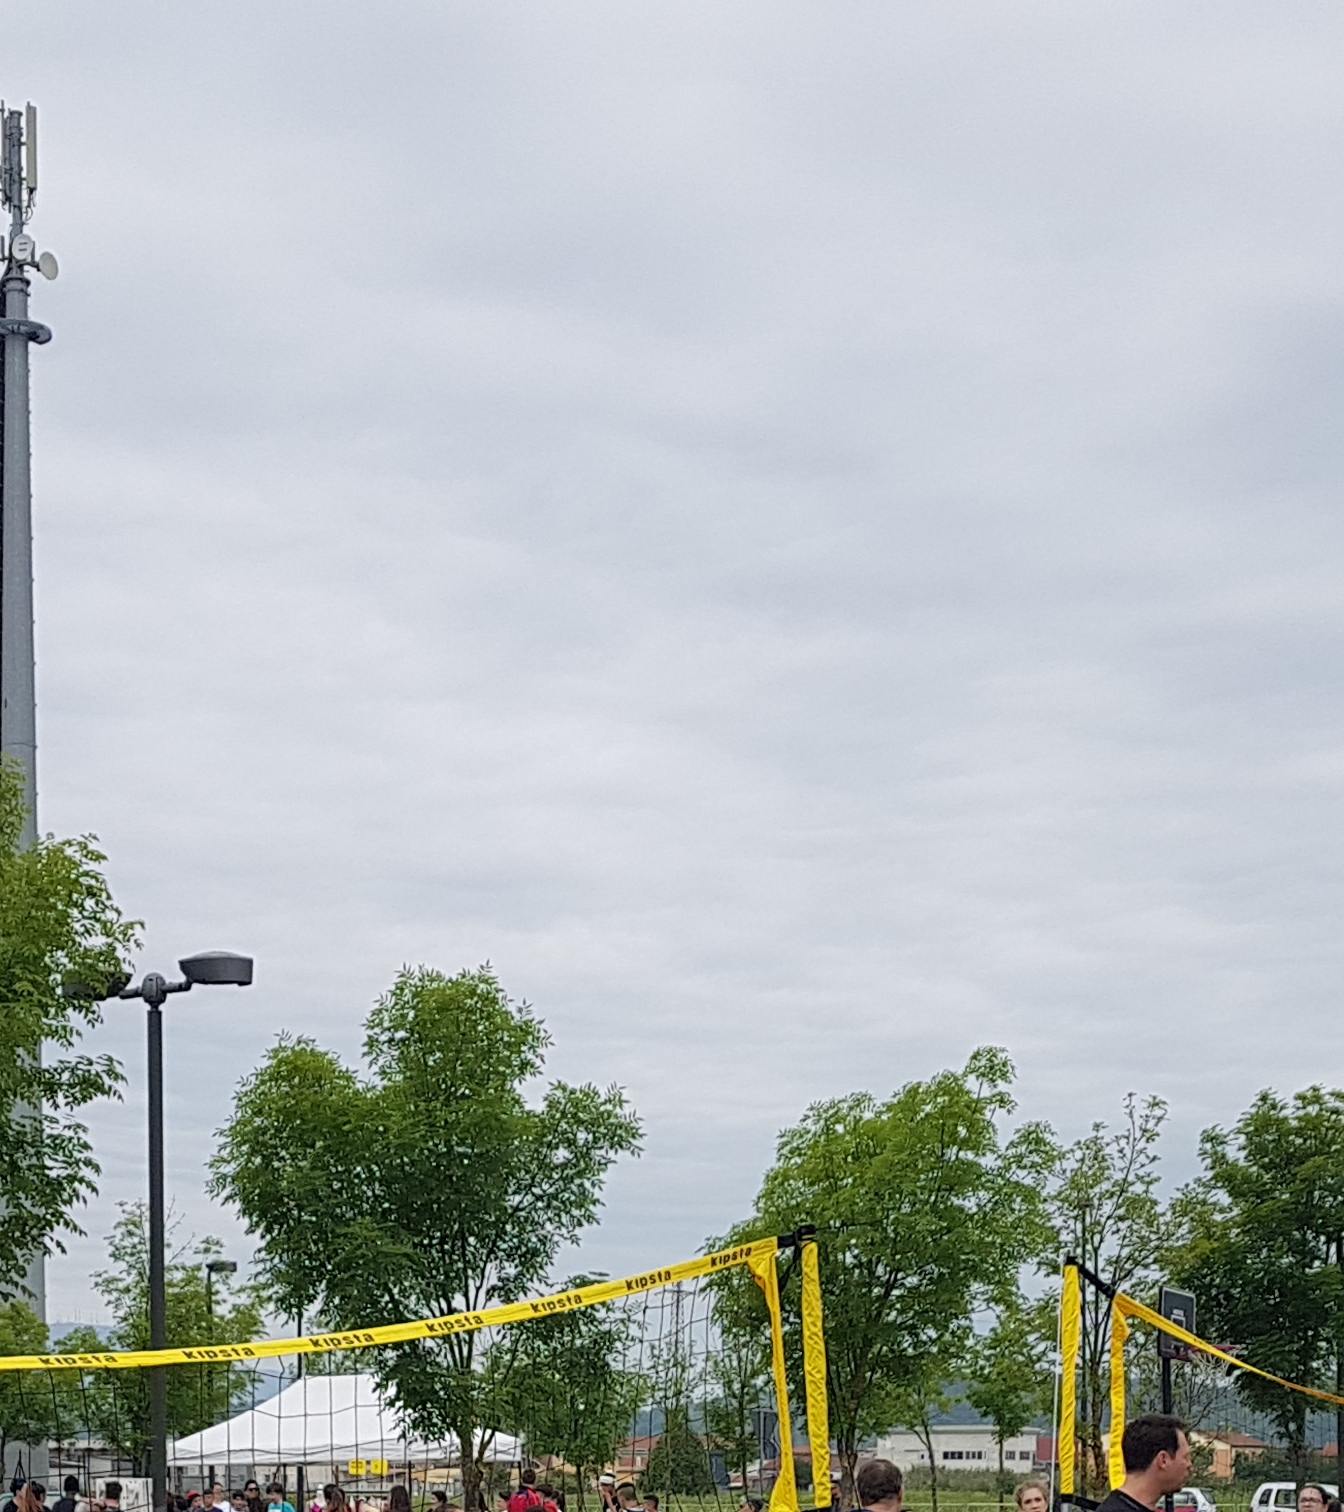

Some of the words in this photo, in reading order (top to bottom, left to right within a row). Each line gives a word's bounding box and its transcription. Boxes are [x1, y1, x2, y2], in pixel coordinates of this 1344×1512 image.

[710, 1246, 752, 1268] kipsta
[625, 1269, 672, 1292] kipsta
[530, 1293, 583, 1314] kipsta
[425, 1313, 485, 1334] kipsta
[309, 1331, 376, 1349] kipsta
[181, 1345, 256, 1361] kipsta
